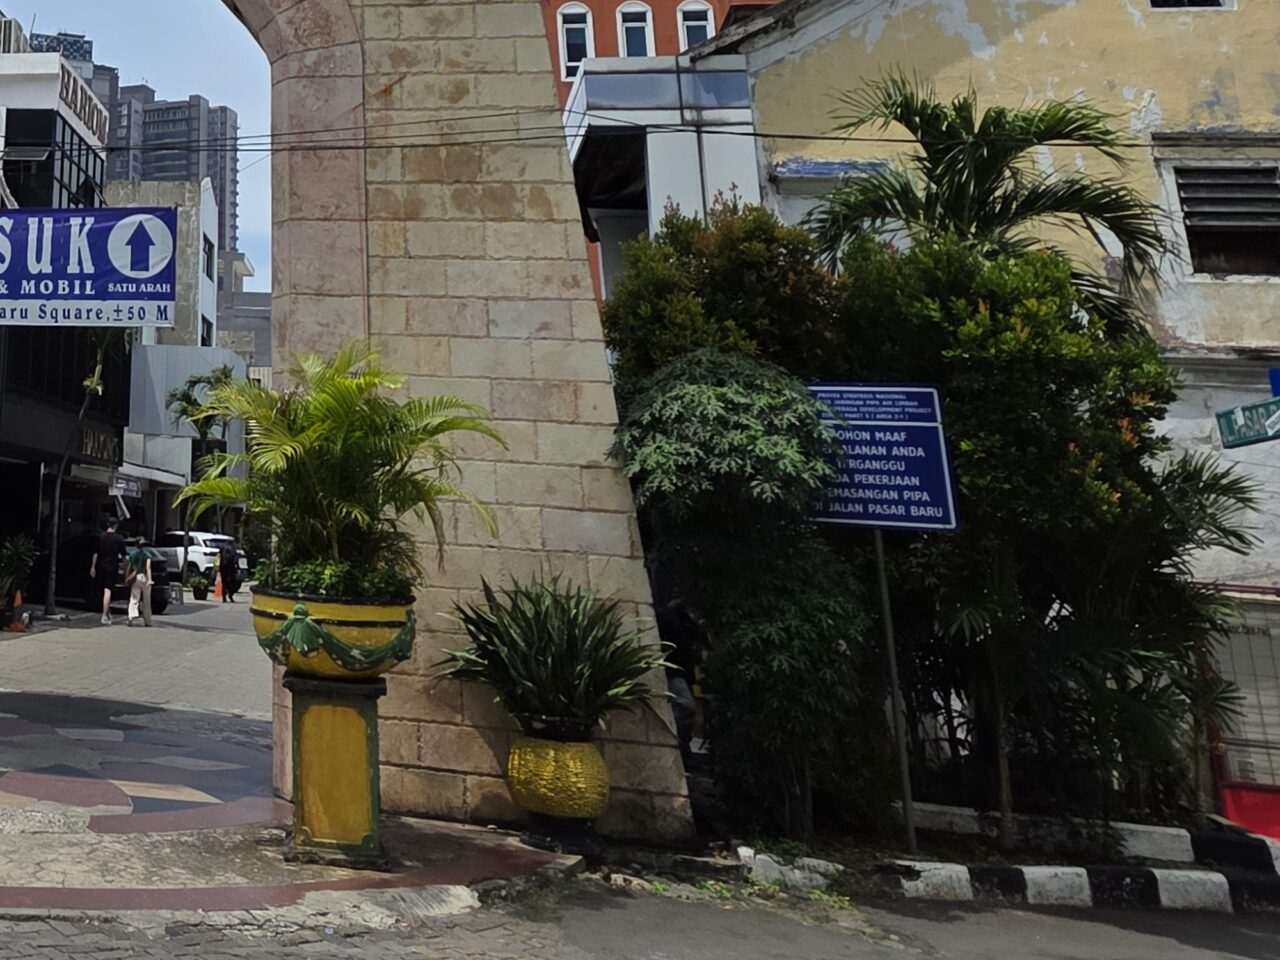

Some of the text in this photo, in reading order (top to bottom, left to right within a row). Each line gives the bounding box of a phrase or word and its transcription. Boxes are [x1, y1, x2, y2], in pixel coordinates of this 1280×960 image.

[60, 63, 110, 146] HARIOM
[20, 279, 95, 295] MOBIL
[107, 283, 170, 293] SATU ARAH
[834, 431, 907, 442] OHON MAAF
[892, 445, 926, 458] ANDA
[854, 474, 920, 486] PEKERJAAN
[824, 487, 931, 502] EMASANGAN PIPA
[828, 503, 864, 513] JALAN
[868, 504, 906, 516] PASAR
[910, 506, 943, 518] BARU
